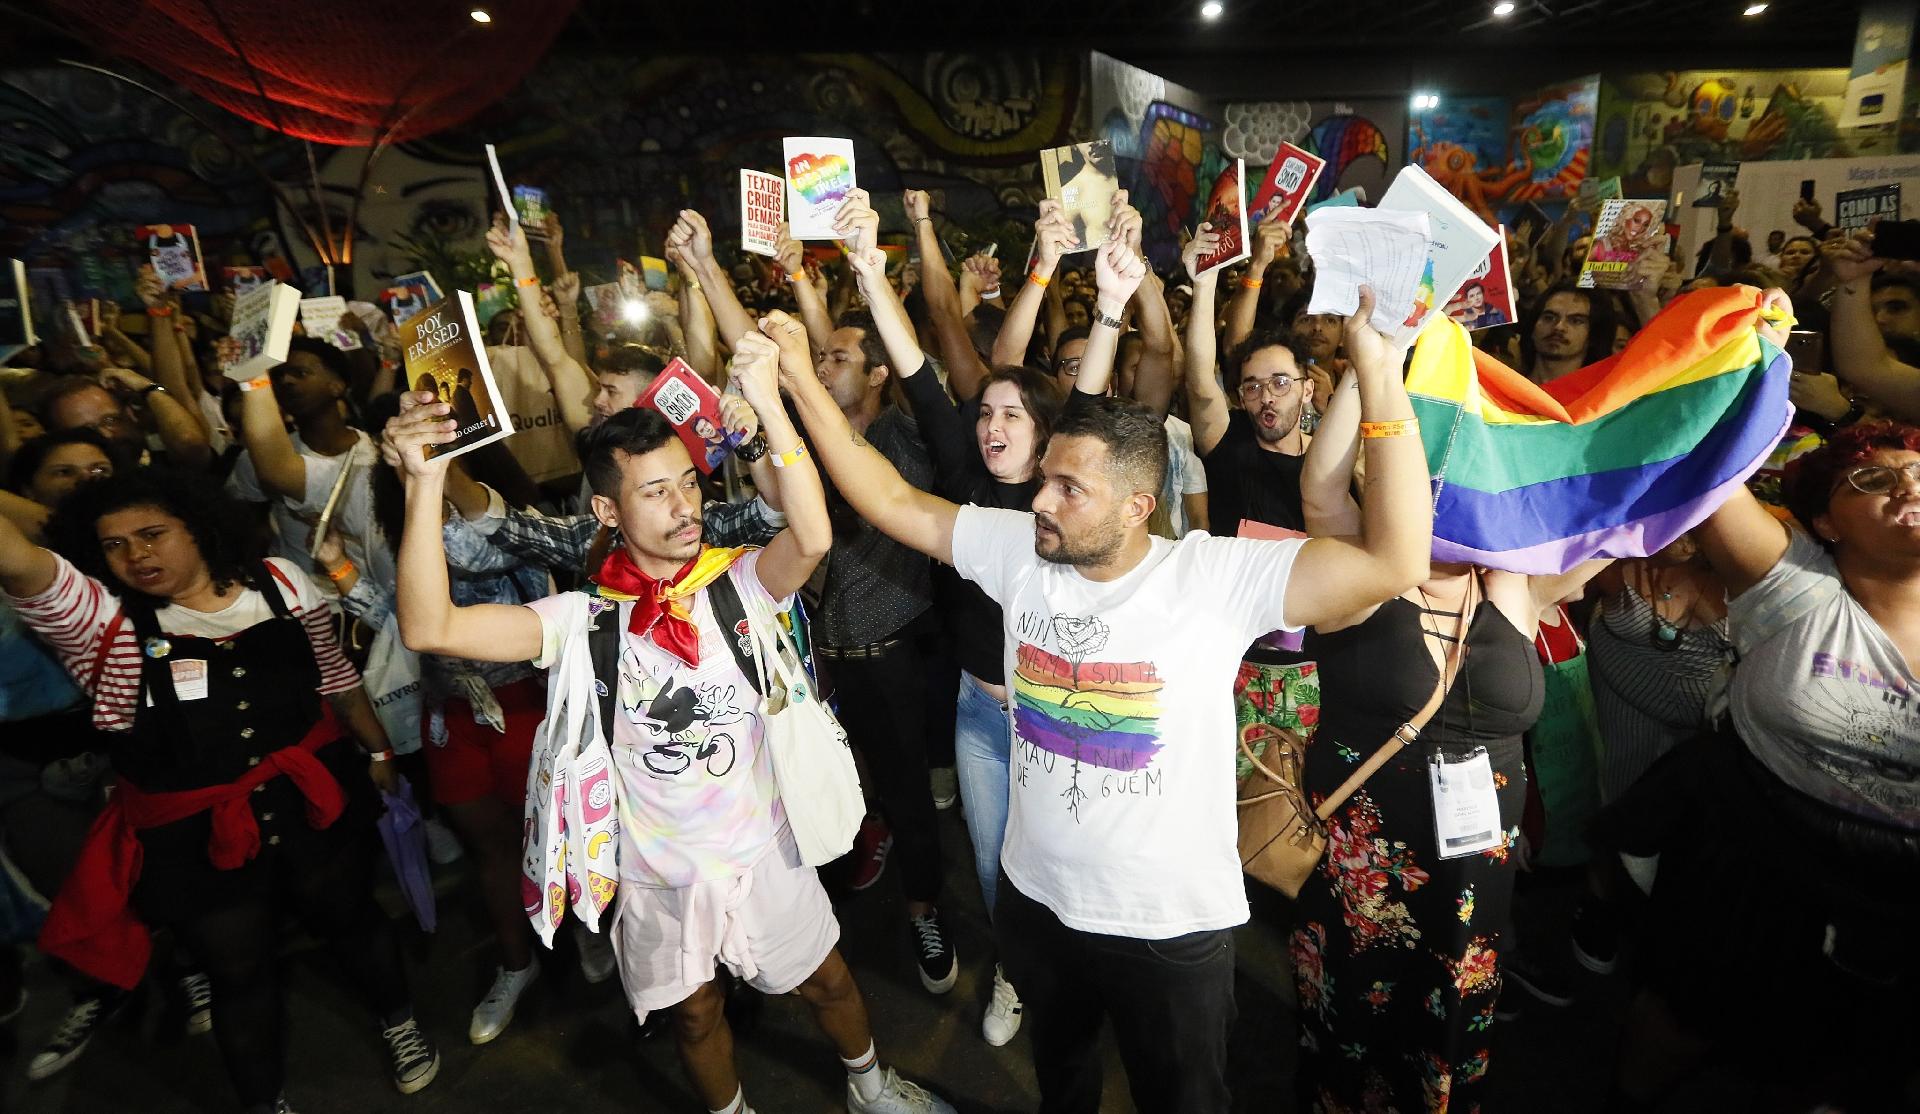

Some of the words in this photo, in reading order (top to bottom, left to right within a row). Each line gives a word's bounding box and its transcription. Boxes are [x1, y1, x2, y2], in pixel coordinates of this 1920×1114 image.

[746, 174, 781, 197] TEXTOS
[747, 190, 781, 213] CRUEIS
[1839, 197, 1877, 217] COMO
[1880, 194, 1897, 212] AS
[747, 206, 781, 228] DEMAIS
[416, 312, 442, 340] BOY
[408, 322, 459, 361] ERASED
[666, 389, 697, 422] SIMON
[463, 419, 488, 436] CONLEY
[1017, 766, 1028, 788] DE
